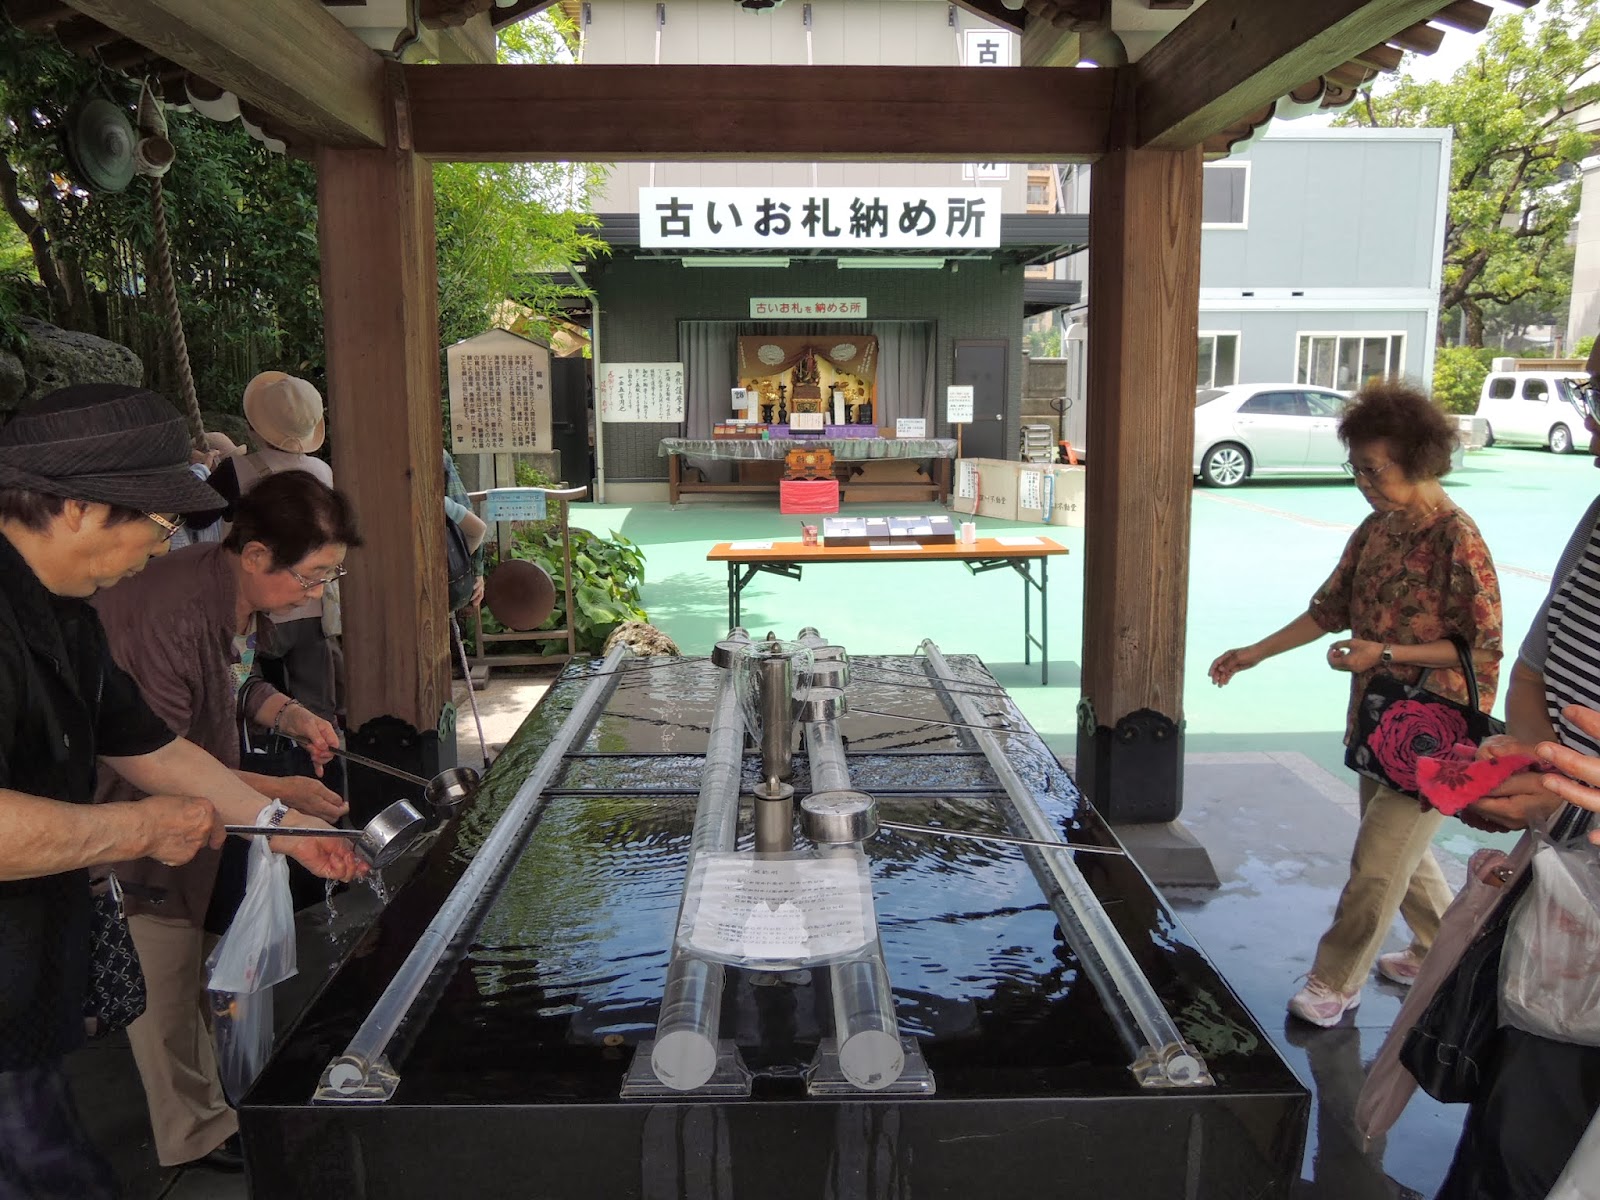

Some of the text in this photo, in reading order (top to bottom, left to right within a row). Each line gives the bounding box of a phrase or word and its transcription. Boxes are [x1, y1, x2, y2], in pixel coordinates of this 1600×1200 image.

[655, 196, 986, 238] 古いお札納め所
[755, 302, 862, 314] 古いお札を納める所
